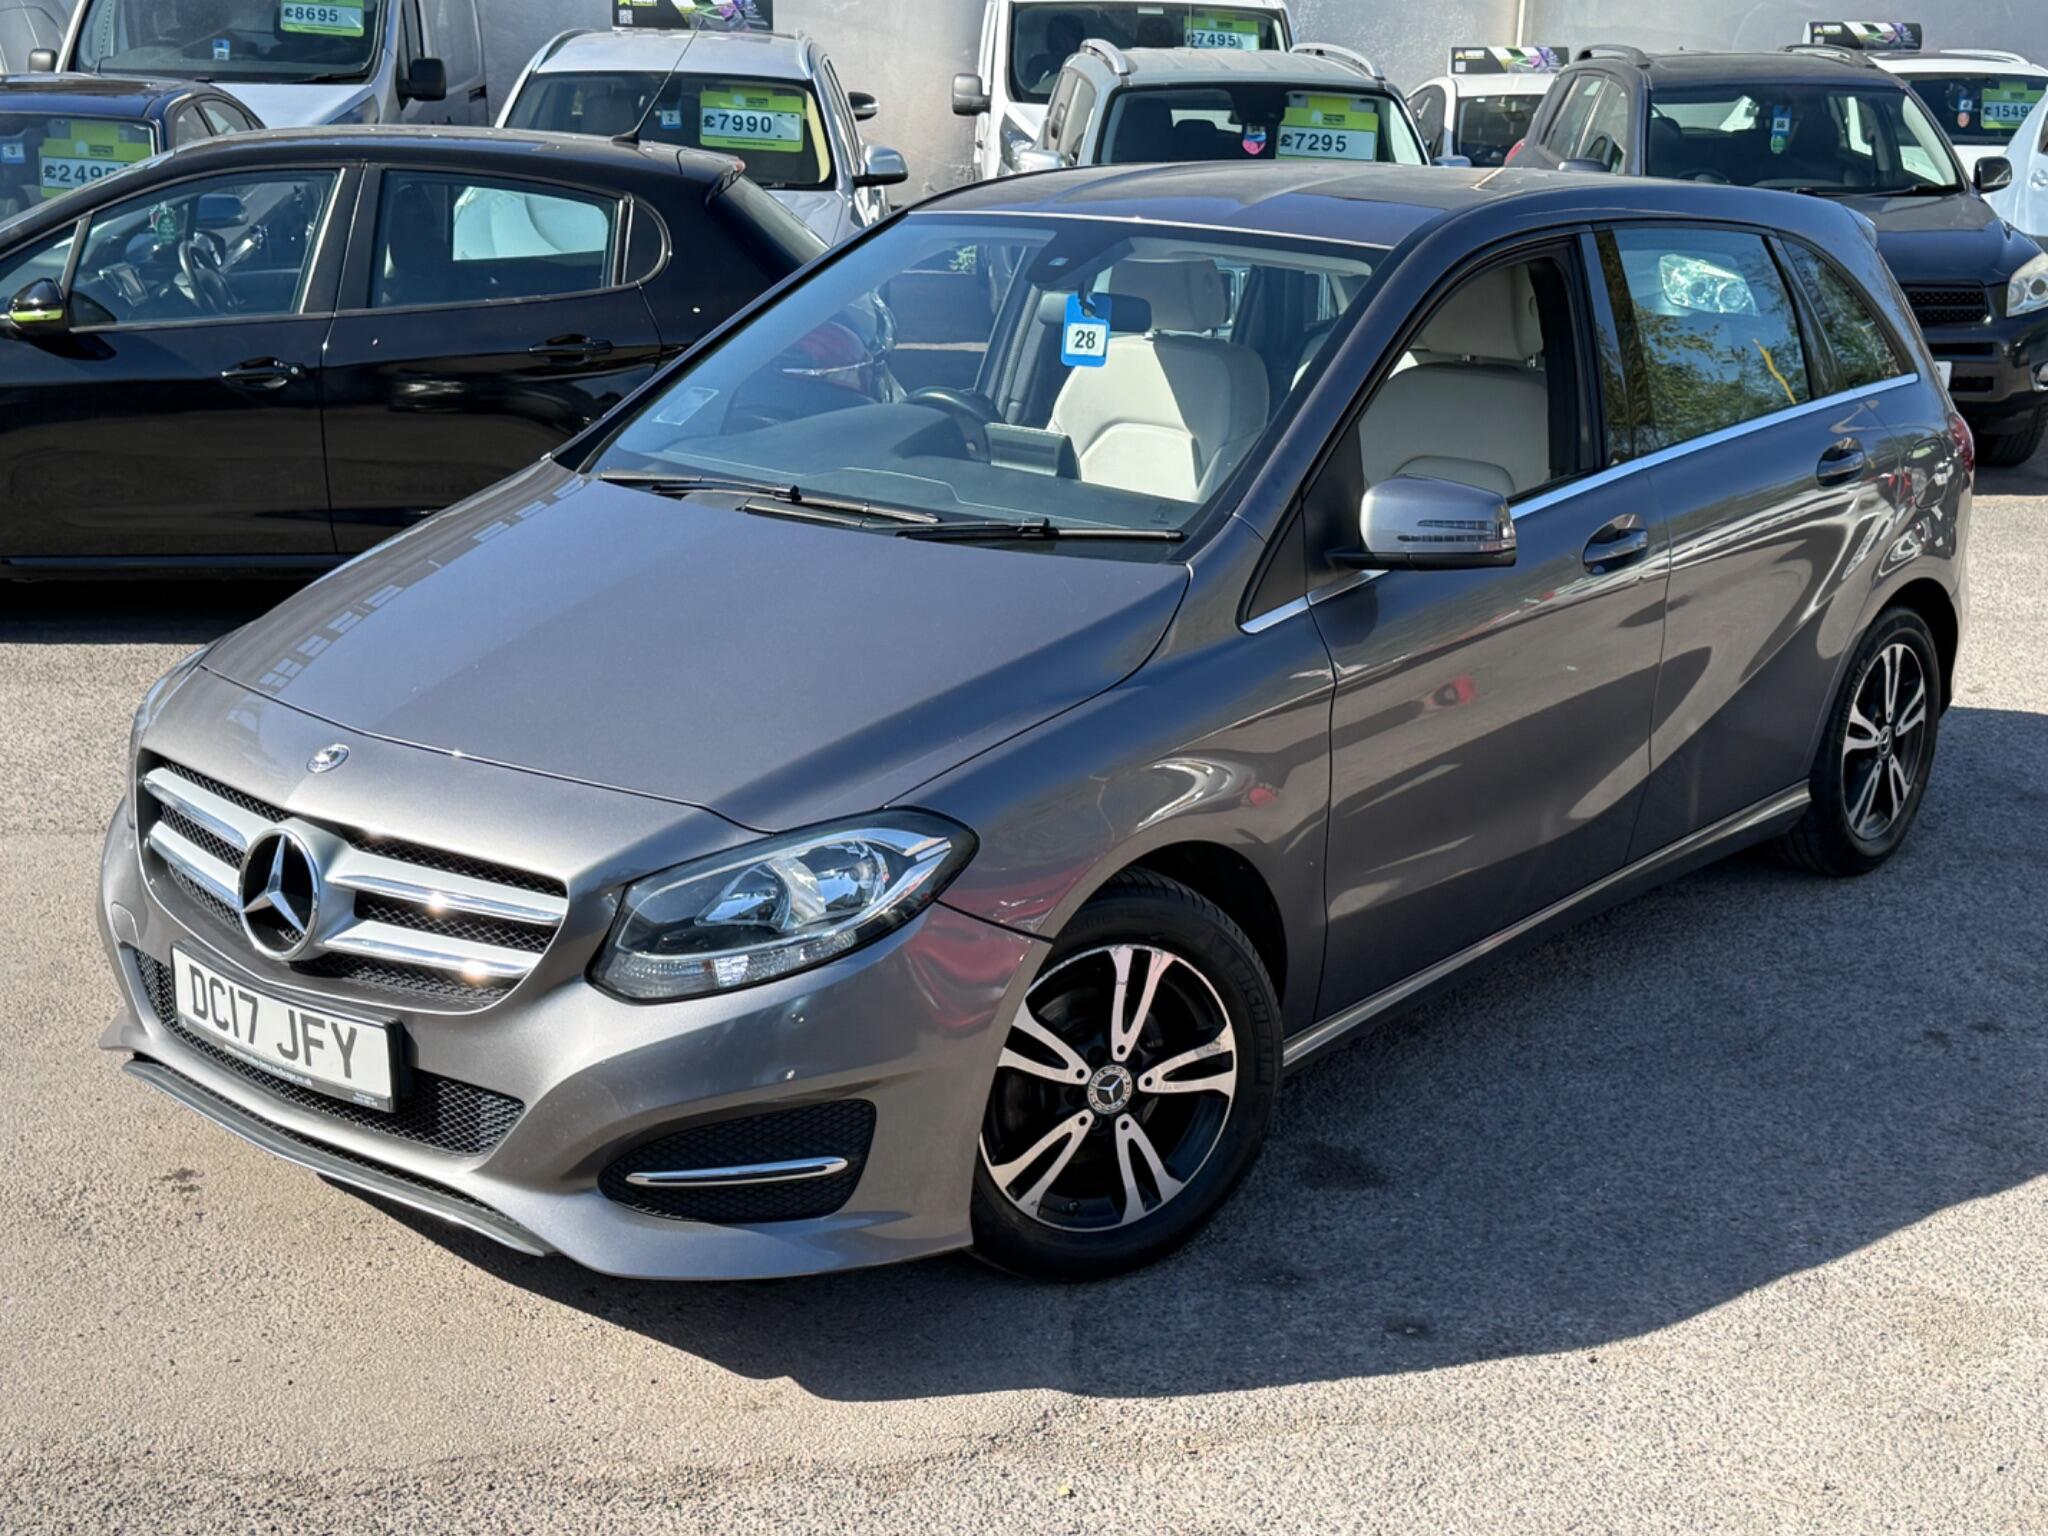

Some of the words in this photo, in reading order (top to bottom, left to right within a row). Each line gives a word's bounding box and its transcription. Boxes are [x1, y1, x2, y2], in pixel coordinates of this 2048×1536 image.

[284, 7, 338, 22] £8695
[1984, 105, 2037, 118] £1549
[704, 114, 772, 133] £7990
[1280, 133, 1347, 152] £7295
[1074, 330, 1096, 349] 28
[189, 964, 259, 1045] DC17
[276, 1008, 357, 1079] JFY
